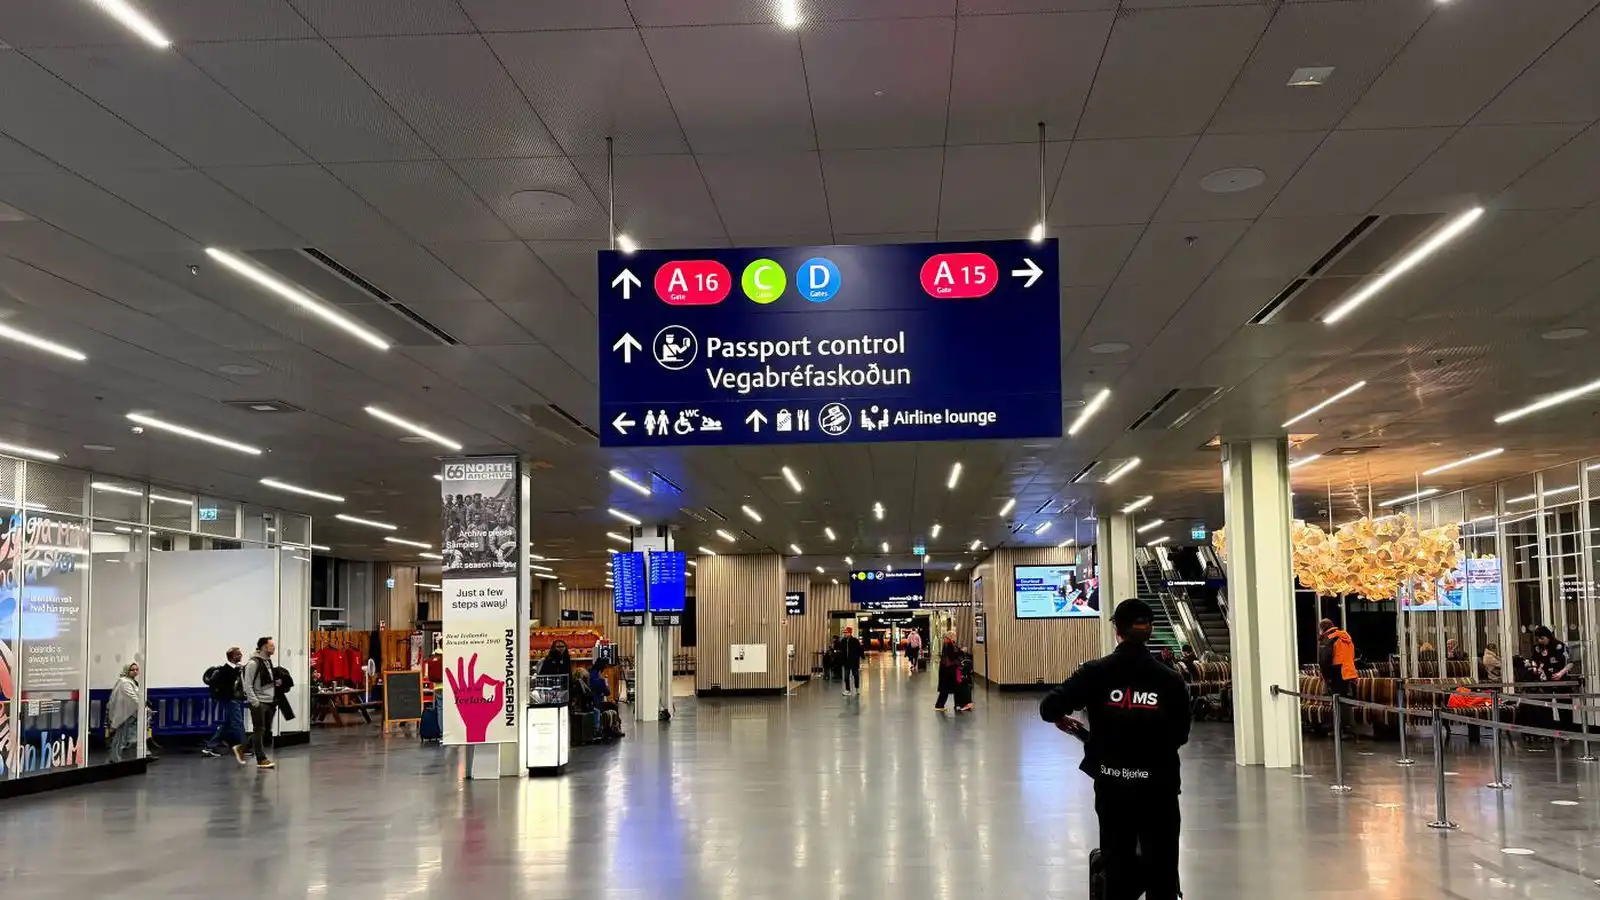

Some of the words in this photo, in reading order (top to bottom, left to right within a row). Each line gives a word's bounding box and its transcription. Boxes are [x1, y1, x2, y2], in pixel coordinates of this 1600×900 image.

[754, 265, 773, 290] C
[809, 265, 830, 289] D
[934, 261, 954, 285] A
[961, 265, 986, 285] 15
[667, 268, 688, 292] A
[695, 273, 719, 292] 16
[706, 337, 811, 363] Passport
[817, 331, 905, 356] control
[706, 363, 911, 394] Vegabréfaskoðun
[685, 409, 699, 418] WC
[894, 409, 942, 425] Airline
[945, 409, 995, 427] lounge
[466, 463, 512, 472] NORTH
[467, 472, 512, 480] ARCHIVE
[459, 529, 487, 538] Archive
[446, 541, 479, 550] Samples
[446, 561, 463, 569] Last
[456, 589, 476, 597] Just
[487, 588, 503, 597] few
[452, 600, 478, 610] steps
[481, 598, 508, 610] away!
[1100, 764, 1121, 777] Sune
